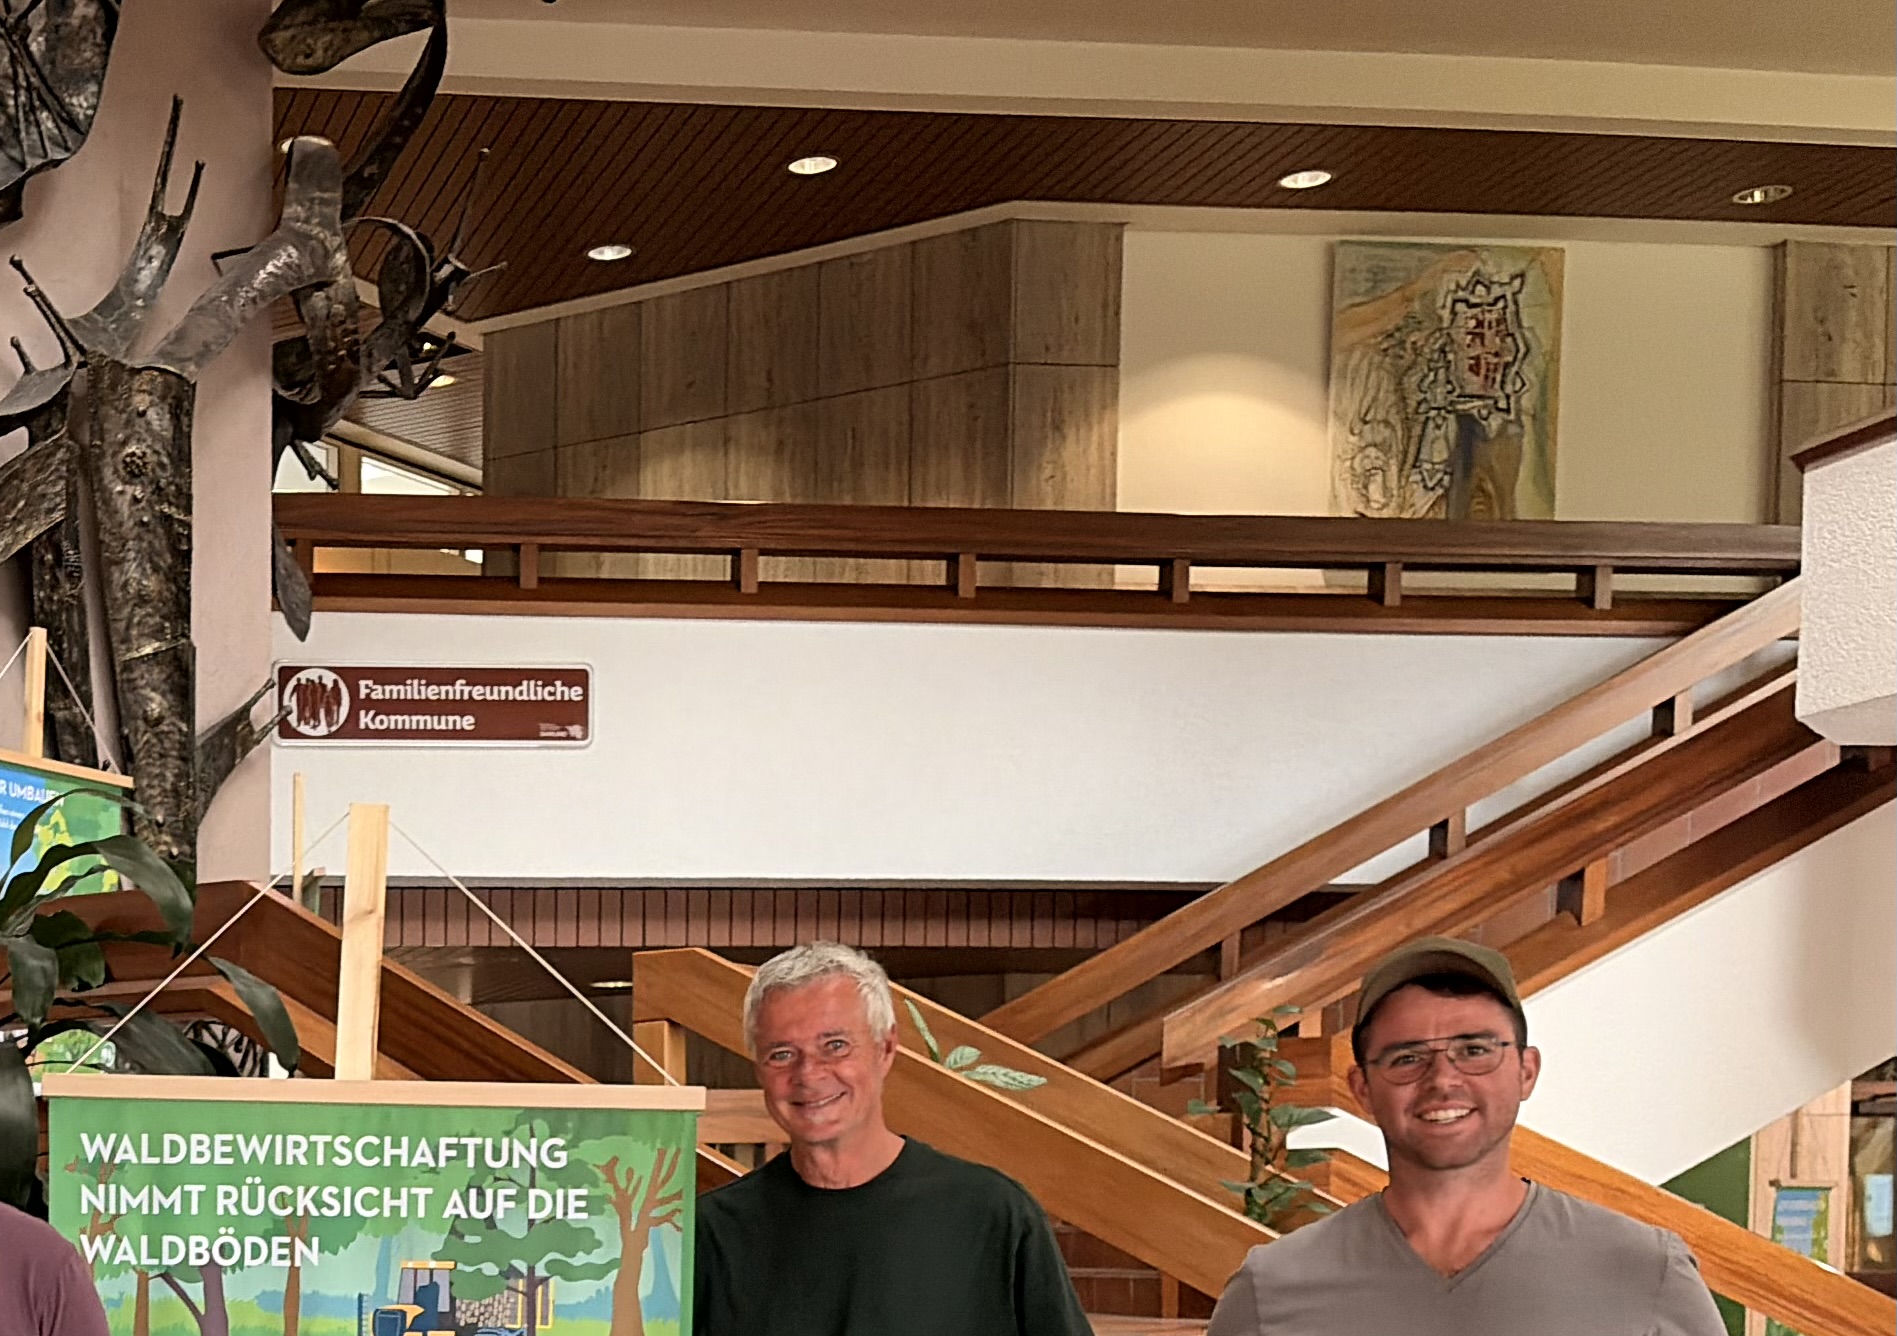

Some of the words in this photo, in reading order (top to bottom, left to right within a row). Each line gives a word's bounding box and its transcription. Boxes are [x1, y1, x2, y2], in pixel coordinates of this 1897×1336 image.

[358, 678, 584, 701] Familienfreundliche
[359, 709, 475, 731] Kommune
[80, 1132, 568, 1169] WALDBEWIRTSCHAFTUNG
[80, 1183, 207, 1216] NIMMT
[216, 1176, 432, 1218] RÜCKSICHT
[442, 1187, 517, 1220] AUF
[528, 1188, 589, 1220] DIE
[79, 1226, 320, 1268] WALDBÖDEN
